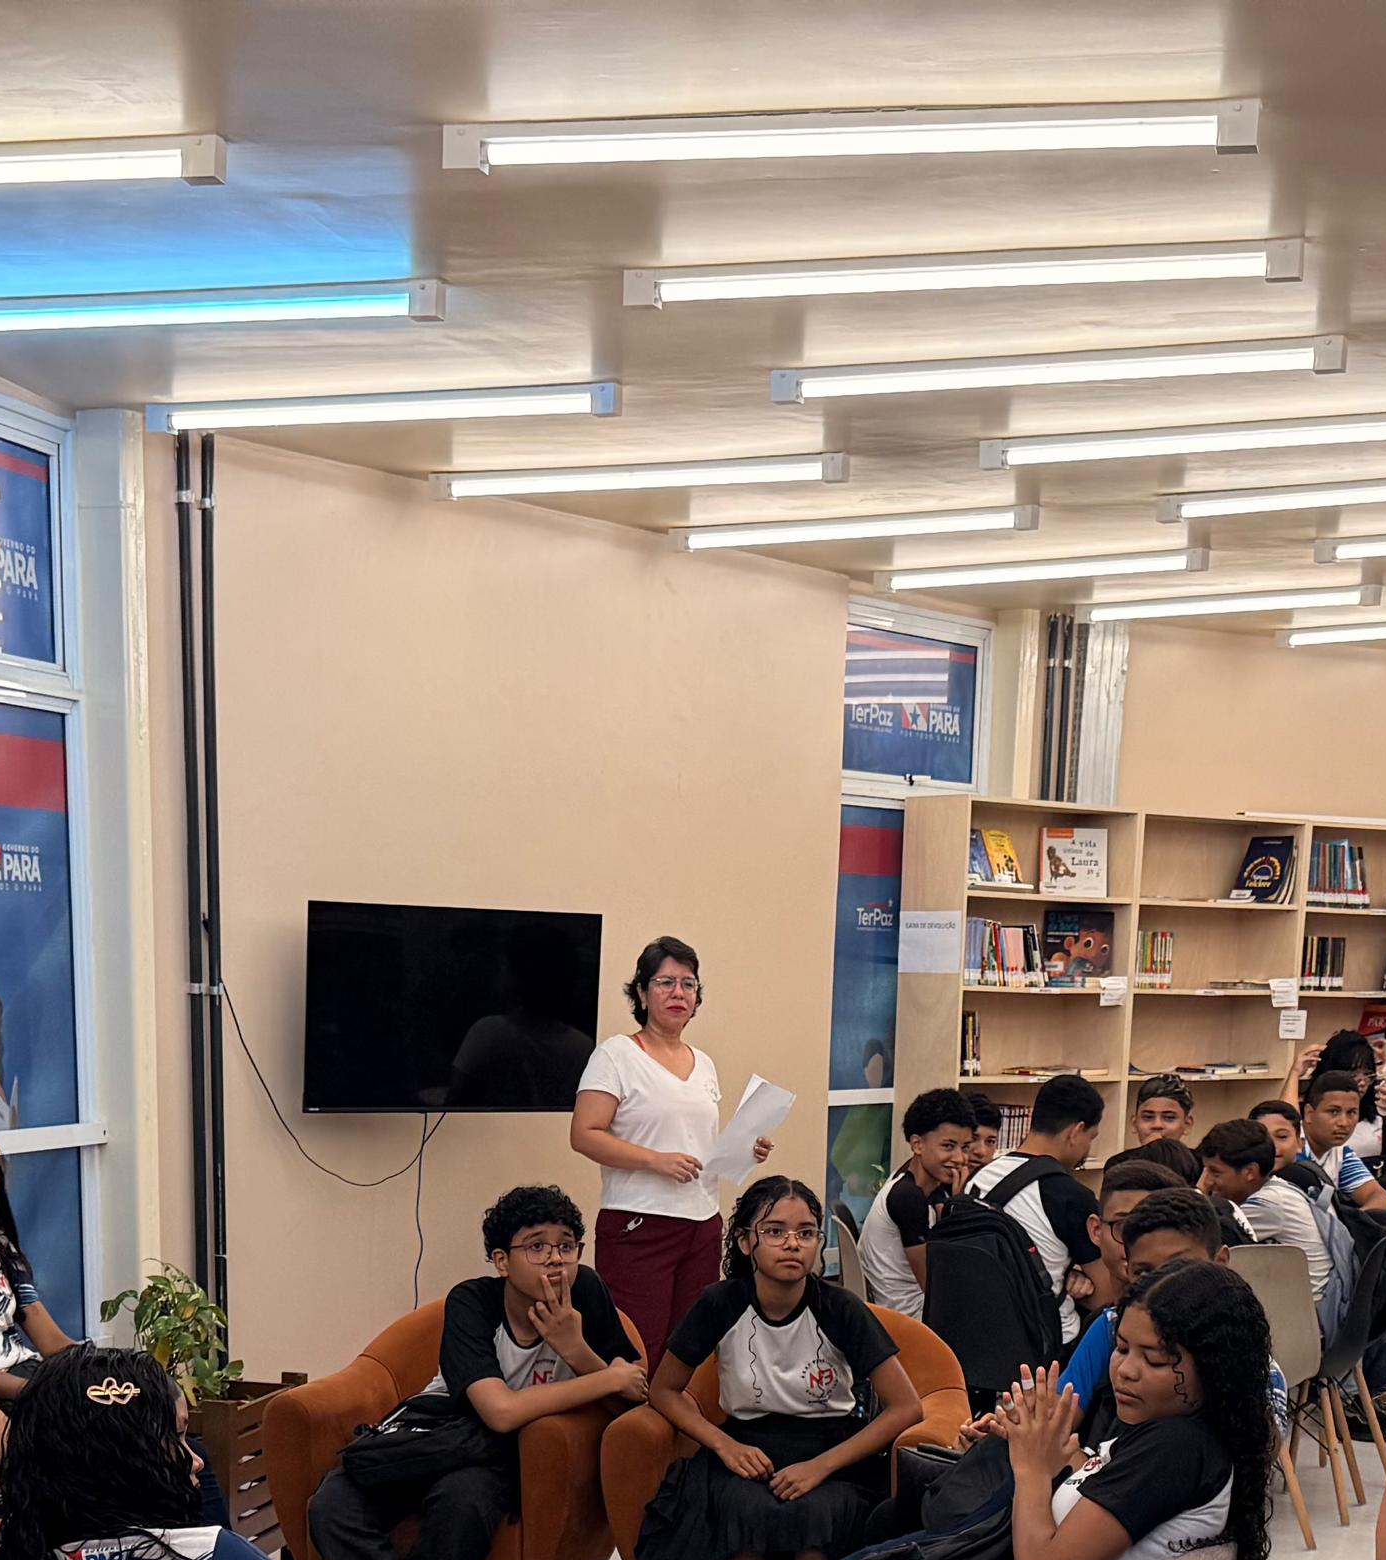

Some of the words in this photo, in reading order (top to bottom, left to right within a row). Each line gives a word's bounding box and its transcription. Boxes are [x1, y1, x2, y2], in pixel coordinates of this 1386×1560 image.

[851, 702, 894, 727] TerPaz
[1071, 857, 1099, 867] Laura
[856, 907, 893, 927] TerPaz
